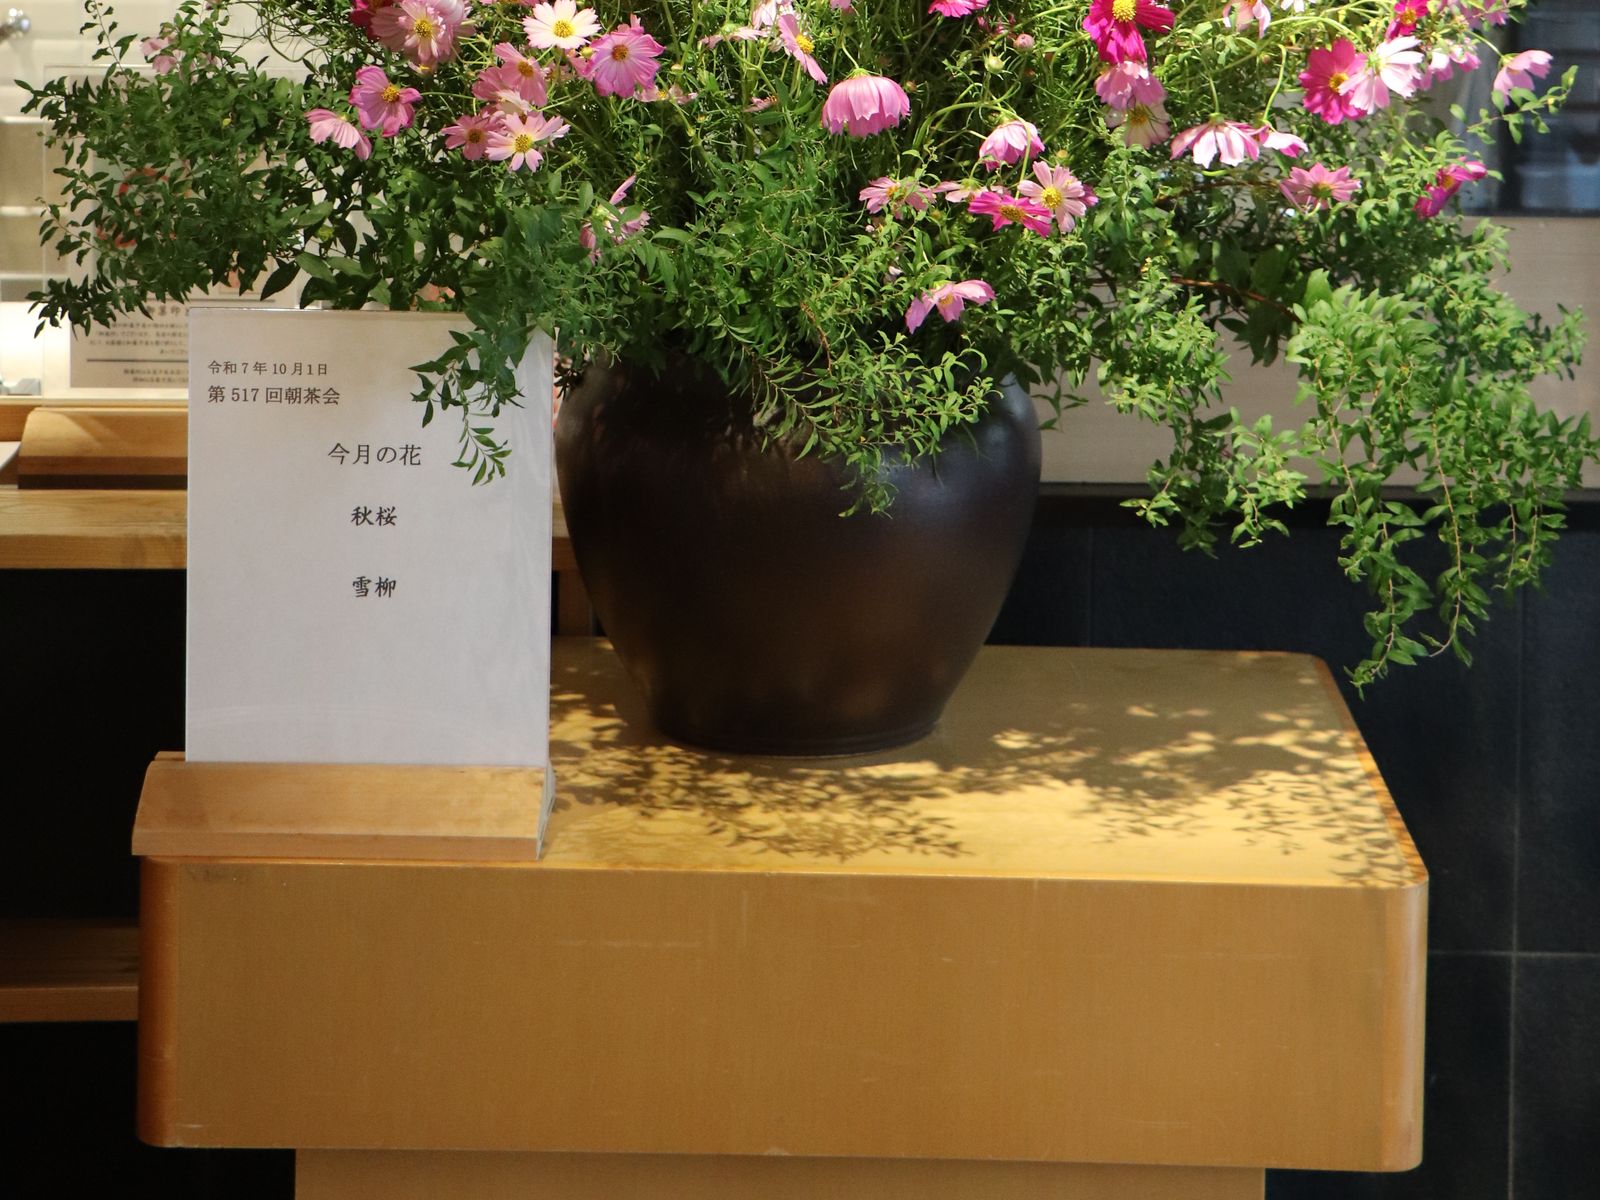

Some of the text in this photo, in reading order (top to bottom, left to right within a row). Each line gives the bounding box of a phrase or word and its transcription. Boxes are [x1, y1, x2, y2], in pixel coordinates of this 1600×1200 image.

[207, 359, 328, 377] 令和7年10月1日
[207, 385, 341, 406] 第517回朝茶会
[327, 442, 422, 466] 今月の花
[350, 505, 398, 527] 秋桜
[352, 575, 397, 599] 雪柳
